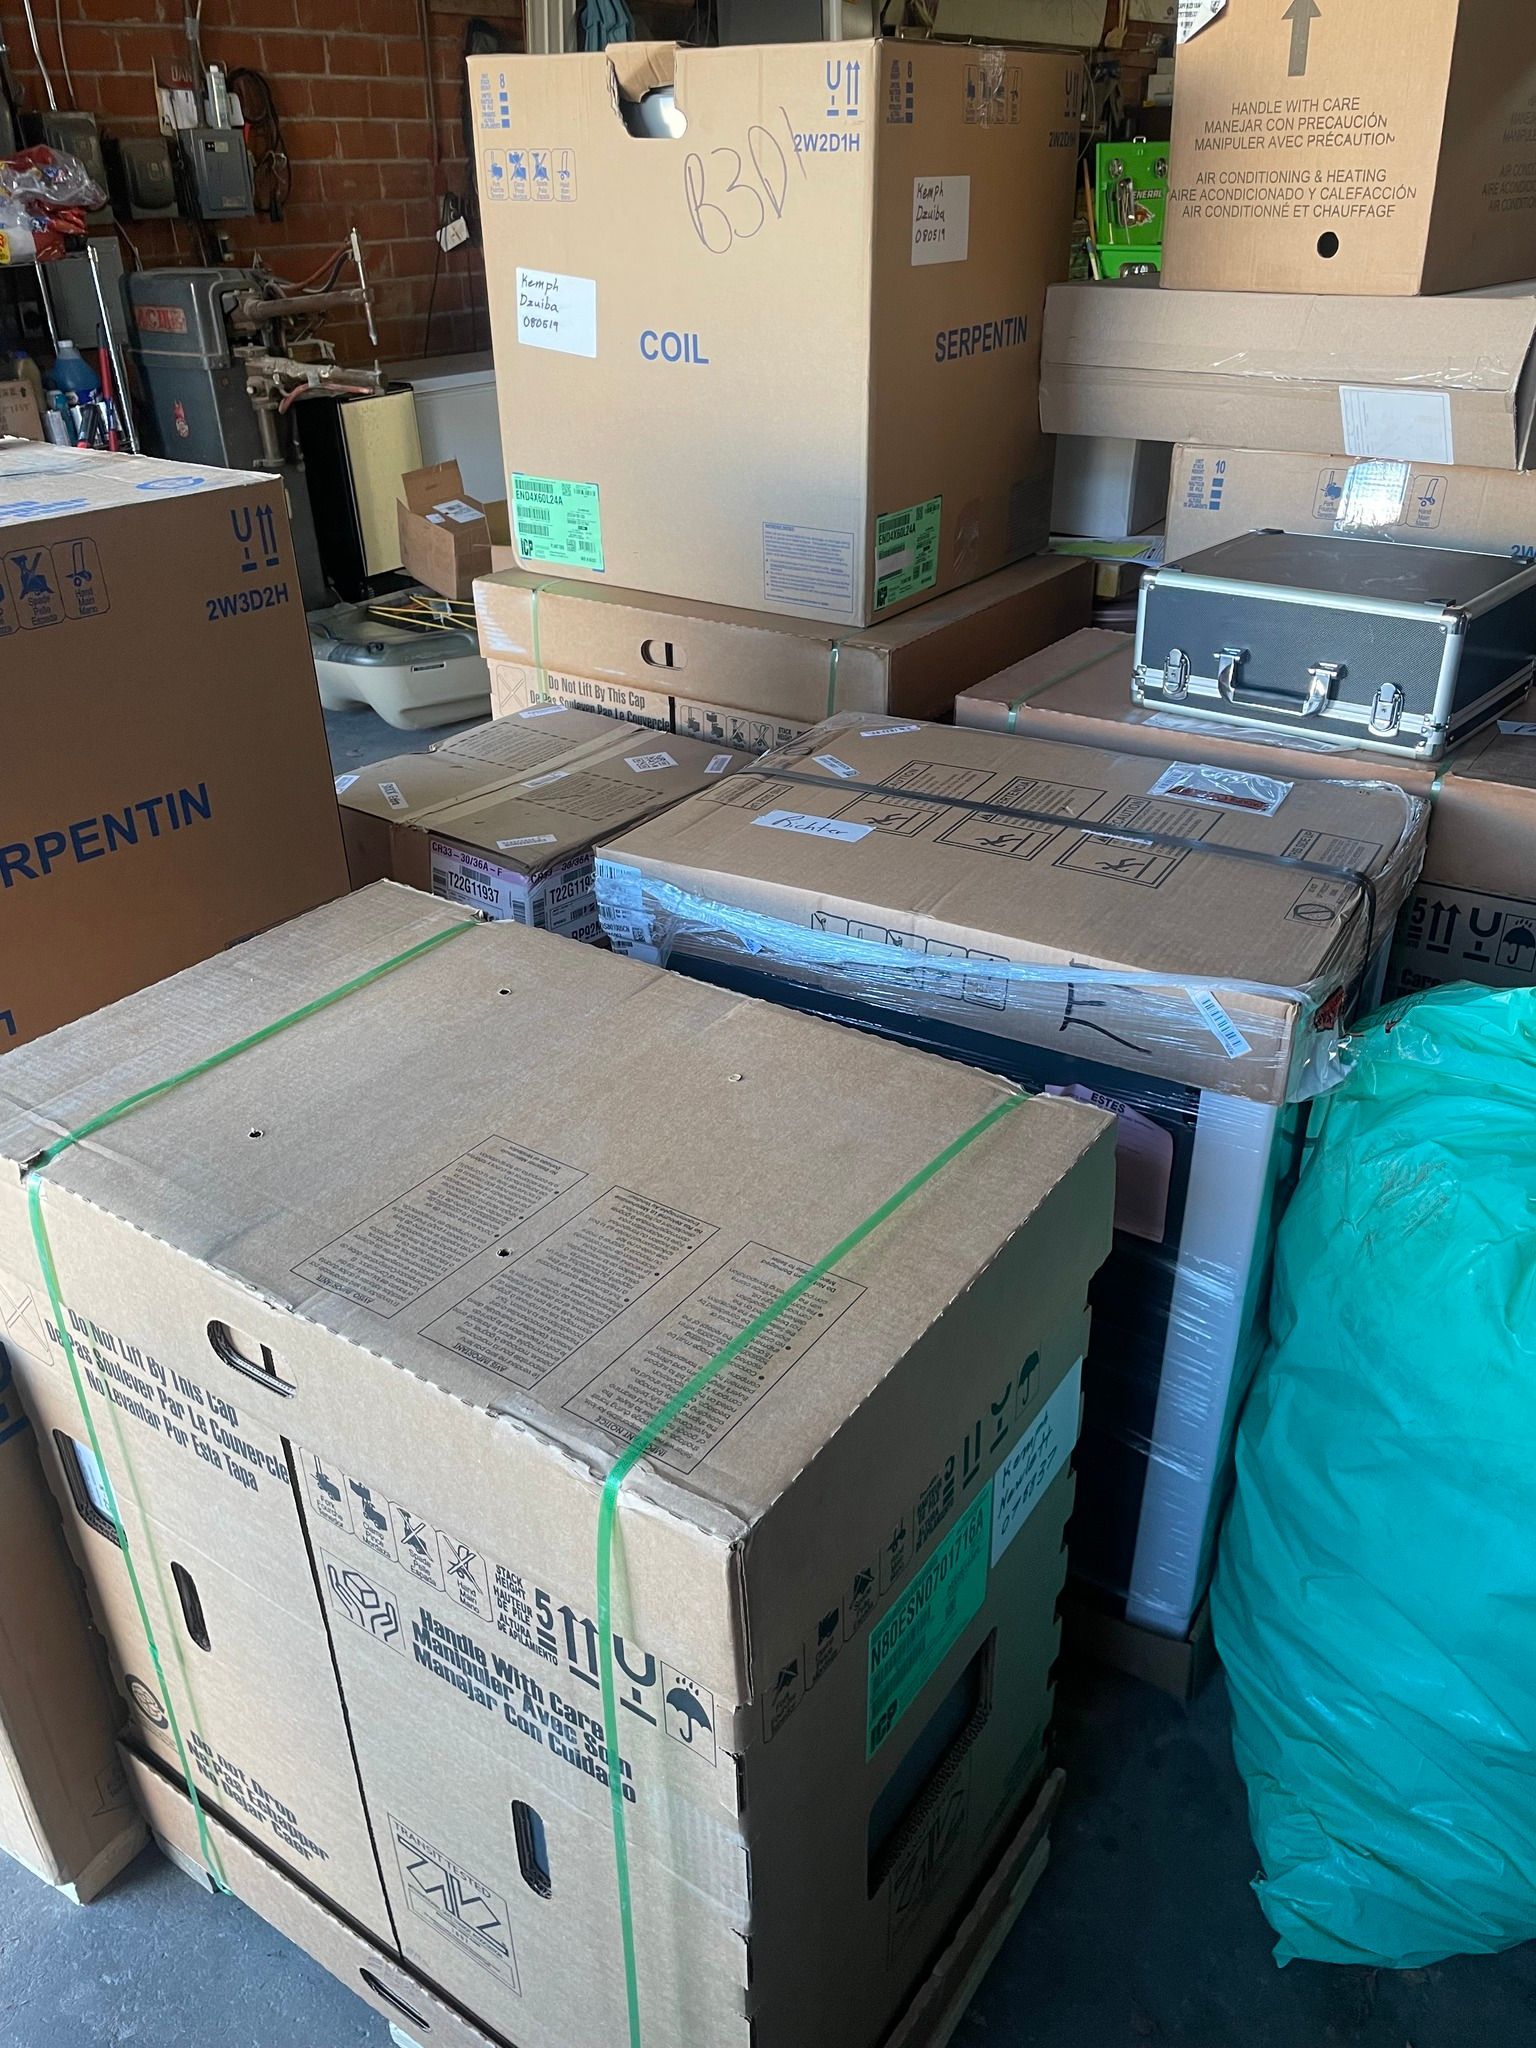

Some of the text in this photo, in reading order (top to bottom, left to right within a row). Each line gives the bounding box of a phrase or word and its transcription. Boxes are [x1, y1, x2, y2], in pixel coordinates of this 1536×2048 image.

[1204, 112, 1388, 134] MANEJAR CON PRECAUCIÓN
[1231, 97, 1361, 116] HANDLE WITH CARE
[793, 133, 860, 153] 2W2D1H
[1195, 131, 1395, 151] MANIPULER AVEC PRÉCAUTION
[916, 181, 944, 202] Kemph
[1170, 183, 1417, 201] AIRE ACONDICIONADO Y CALEFACCIÓN
[1196, 168, 1387, 185] AIR CONDITIONING & HEATING
[1132, 189, 1162, 200] ENERAL
[1182, 201, 1396, 218] AIR CONDITIONNÉ ET CHAUFFAGE
[521, 273, 559, 295] Kemph
[640, 330, 709, 364] COIL
[935, 315, 1029, 362] SERPENTIN
[1215, 459, 1226, 474] 10
[520, 538, 534, 557] ICP
[206, 582, 290, 621] 2W3D2H
[548, 675, 645, 711] Do Not Lift By This Cap
[449, 871, 500, 904] T22G11937
[1091, 1092, 1125, 1113] ESTES
[68, 1308, 239, 1428] Do Not Lift By This Cap
[84, 1366, 259, 1492] No Levantar Por Esta Tapa
[93, 1347, 156, 1401] Soulever
[157, 1386, 186, 1421] Par
[188, 1404, 208, 1436] Le
[209, 1417, 290, 1485] Couvercle
[495, 1563, 524, 1588] STACK
[495, 1574, 527, 1600] HEIGHT
[871, 1506, 984, 1673] N80ESN0701716A
[493, 1585, 533, 1618] HAUTEUR
[497, 1598, 531, 1627] DE PILE
[536, 1587, 554, 1631] 5
[497, 1620, 559, 1666] DE APILAMIENTO
[500, 1615, 531, 1638] ALTURA
[419, 1607, 605, 1742] Handle With Care
[412, 1620, 632, 1781] Manipuler Avec Son
[412, 1641, 637, 1803] Manejar Con Cuidao
[190, 1729, 214, 1758] Do
[250, 1777, 298, 1826] Drop
[195, 1759, 313, 1862] No Dejar Caer
[213, 1760, 244, 1795] Pas
[246, 1787, 330, 1862] Echapper
[394, 1821, 491, 1899] TRANSIT TESTED
